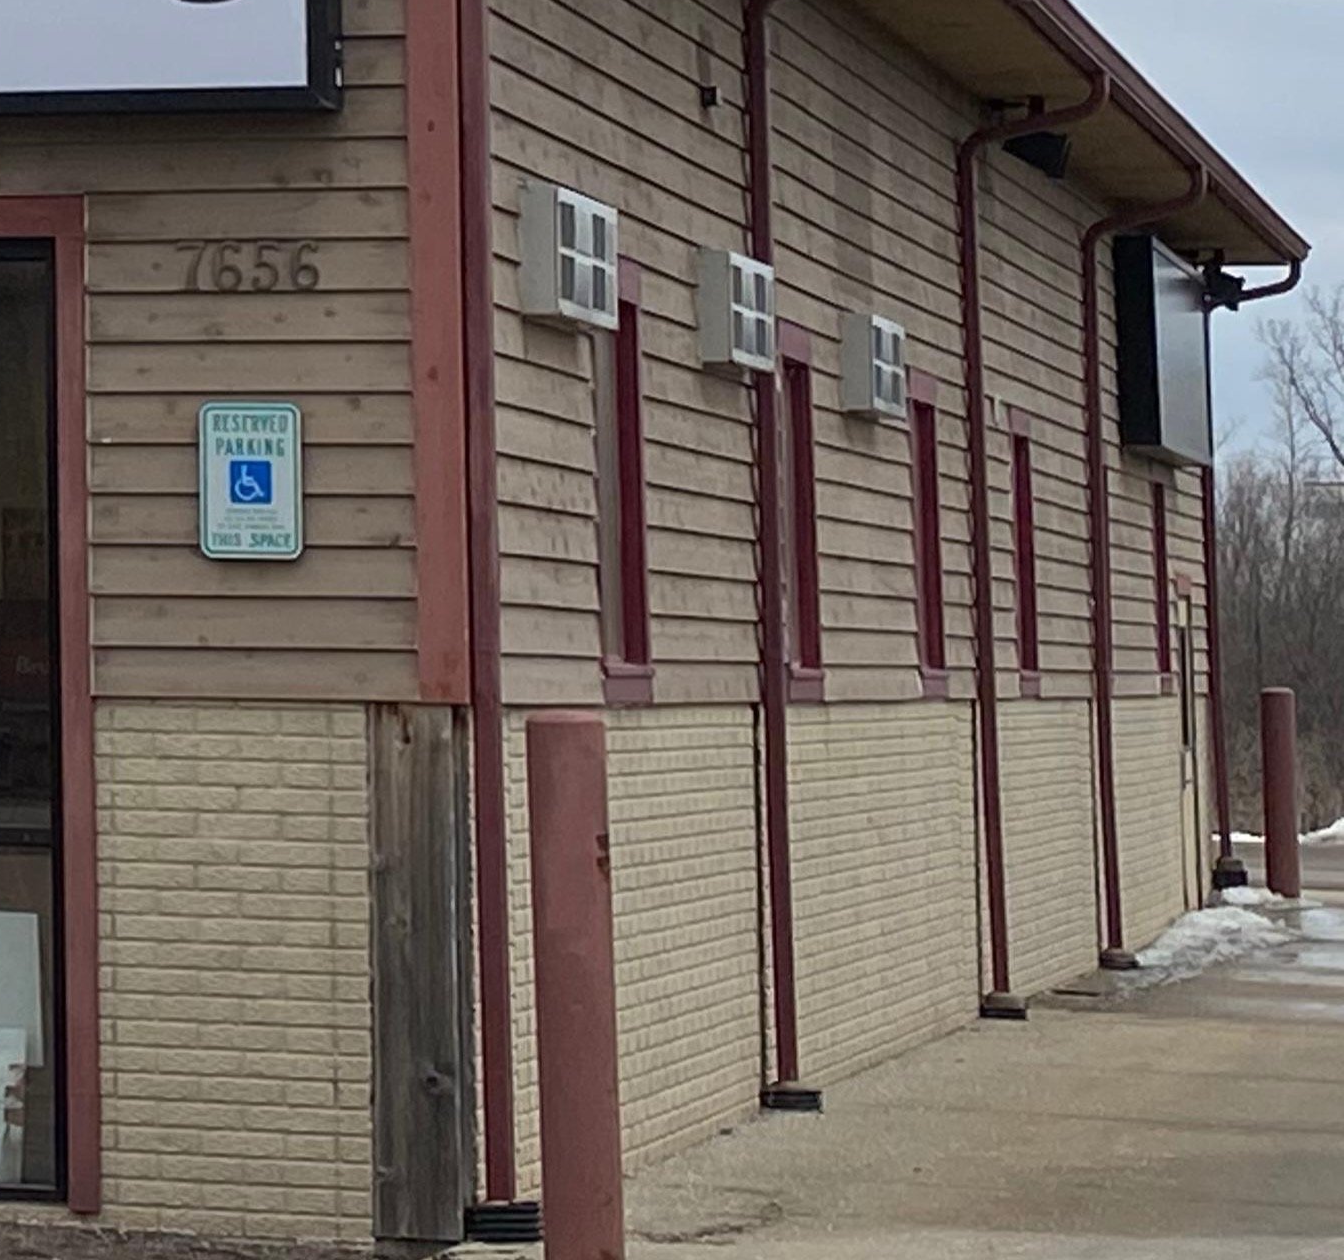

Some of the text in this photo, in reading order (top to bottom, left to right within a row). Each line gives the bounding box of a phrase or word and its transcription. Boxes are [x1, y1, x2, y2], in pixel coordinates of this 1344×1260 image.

[174, 241, 321, 291] 7656
[212, 412, 290, 434] RESERVED
[215, 437, 286, 457] PARKING
[211, 532, 243, 547] THIS
[249, 532, 293, 549] SPACE
